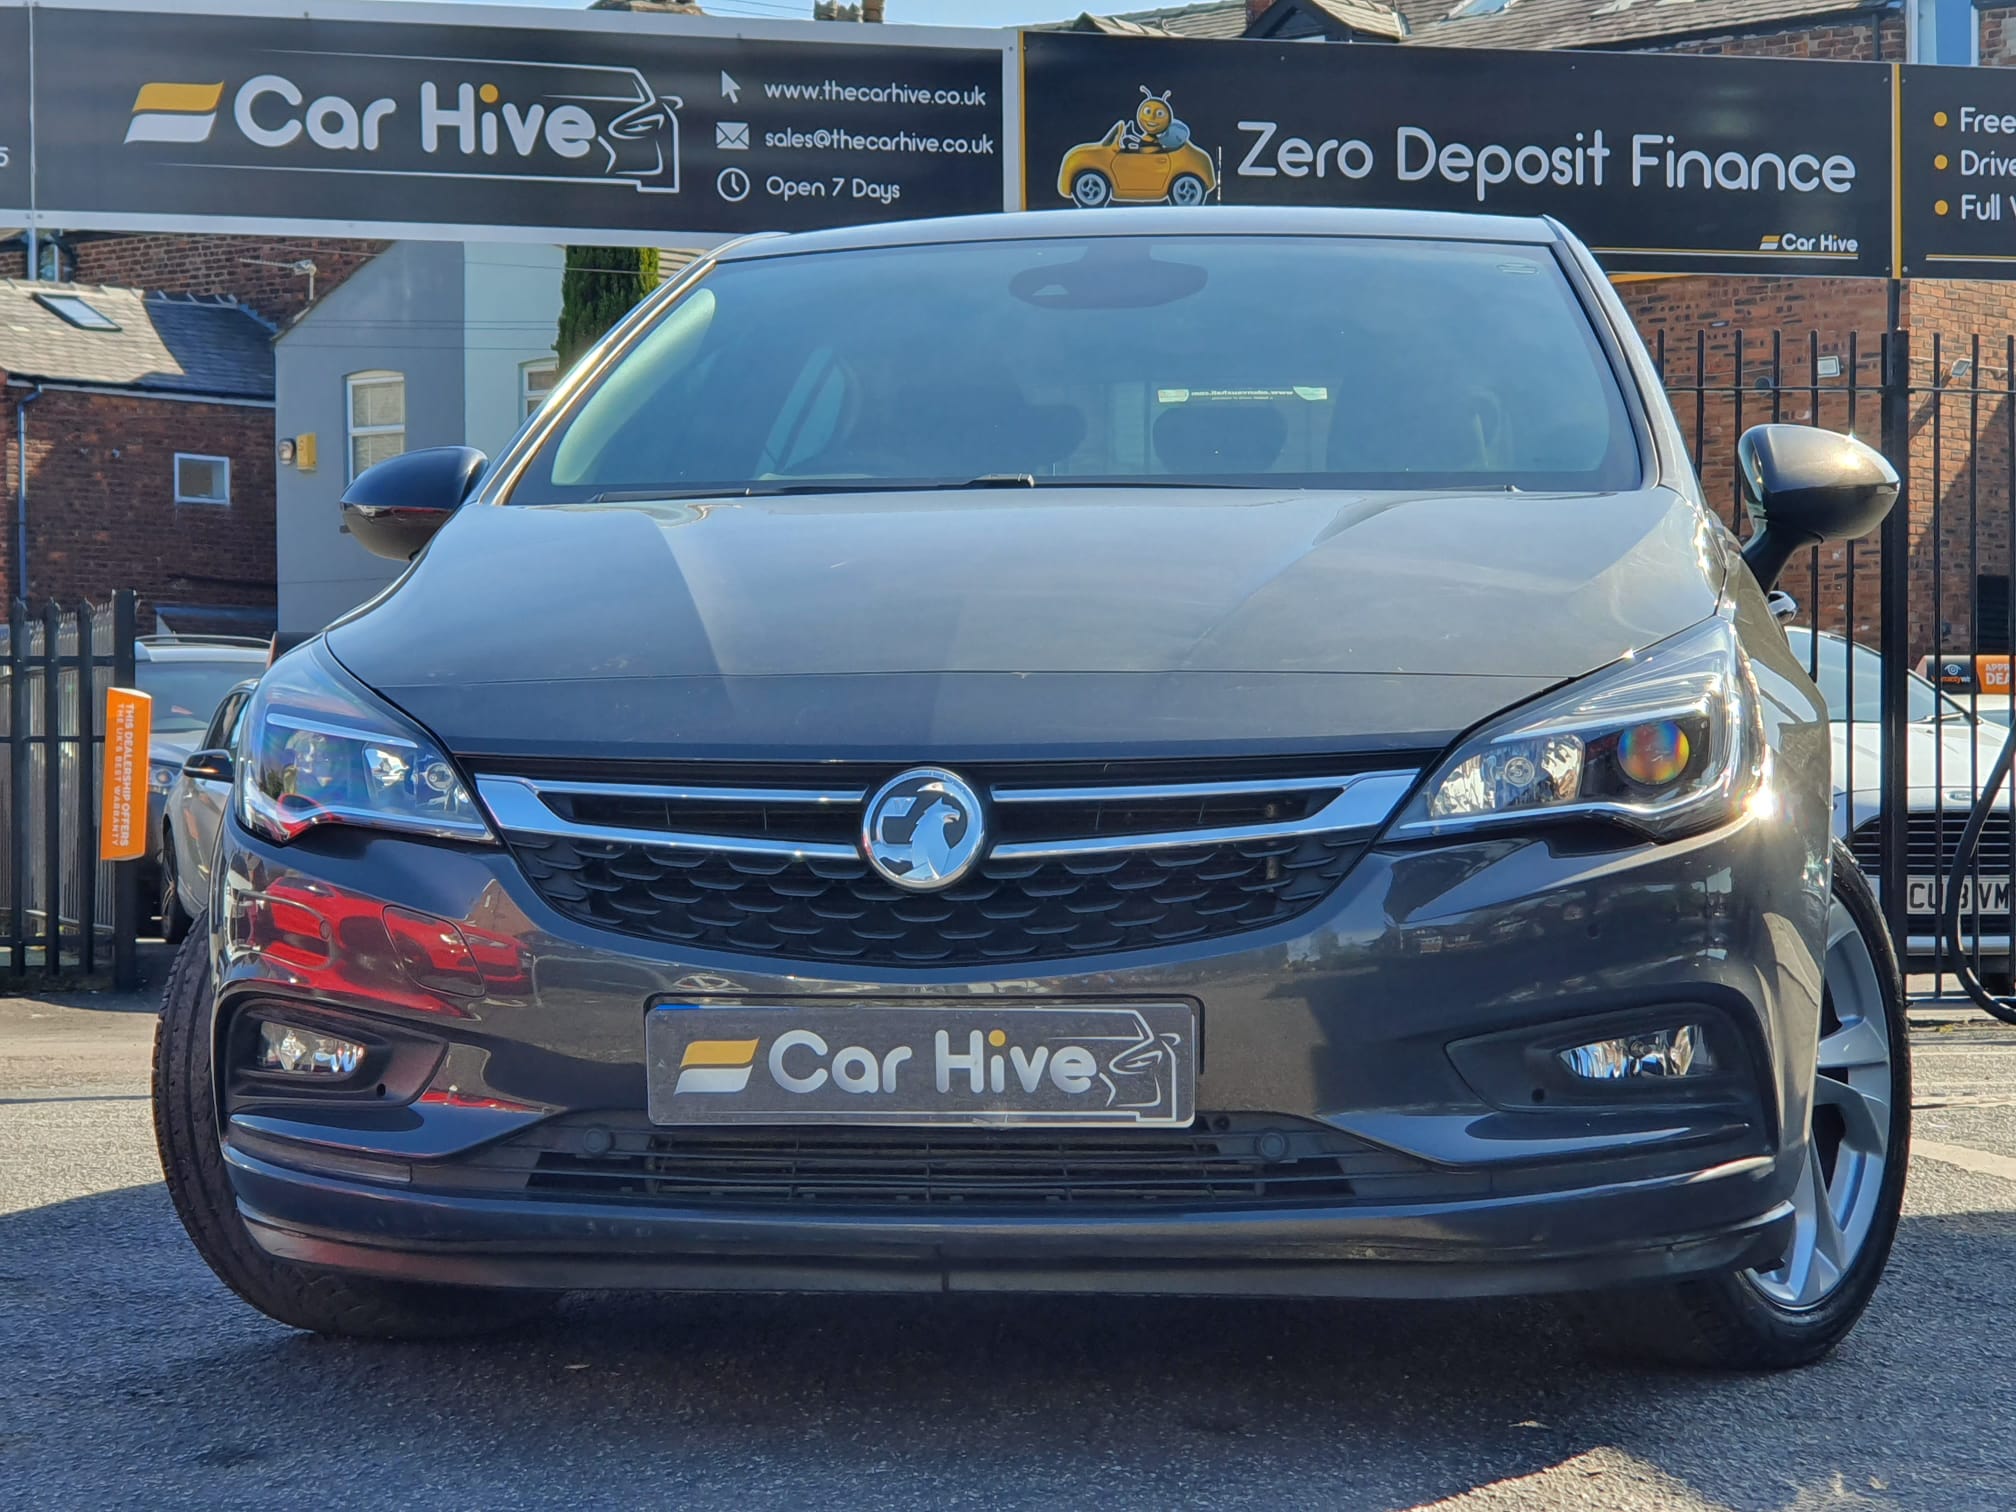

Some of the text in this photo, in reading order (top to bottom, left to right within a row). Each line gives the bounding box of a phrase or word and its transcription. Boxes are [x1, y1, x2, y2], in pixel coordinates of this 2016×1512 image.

[763, 79, 986, 106] www.thecarhive.co.uk
[234, 75, 597, 158] Car Hive
[1960, 106, 2016, 134] Free
[765, 127, 994, 155] sales@thecarhive.co.uk
[1237, 121, 1856, 202] Zero Deposit Finance
[765, 175, 901, 205] Open 7 Days
[1961, 193, 2001, 221] Full
[1781, 233, 1858, 252] Car Hive
[116, 704, 125, 723] THE
[119, 704, 135, 847] THIS DEALERSHIP OFFERS
[112, 786, 121, 846] WARRANTY
[768, 1029, 1097, 1094] Car Hive
